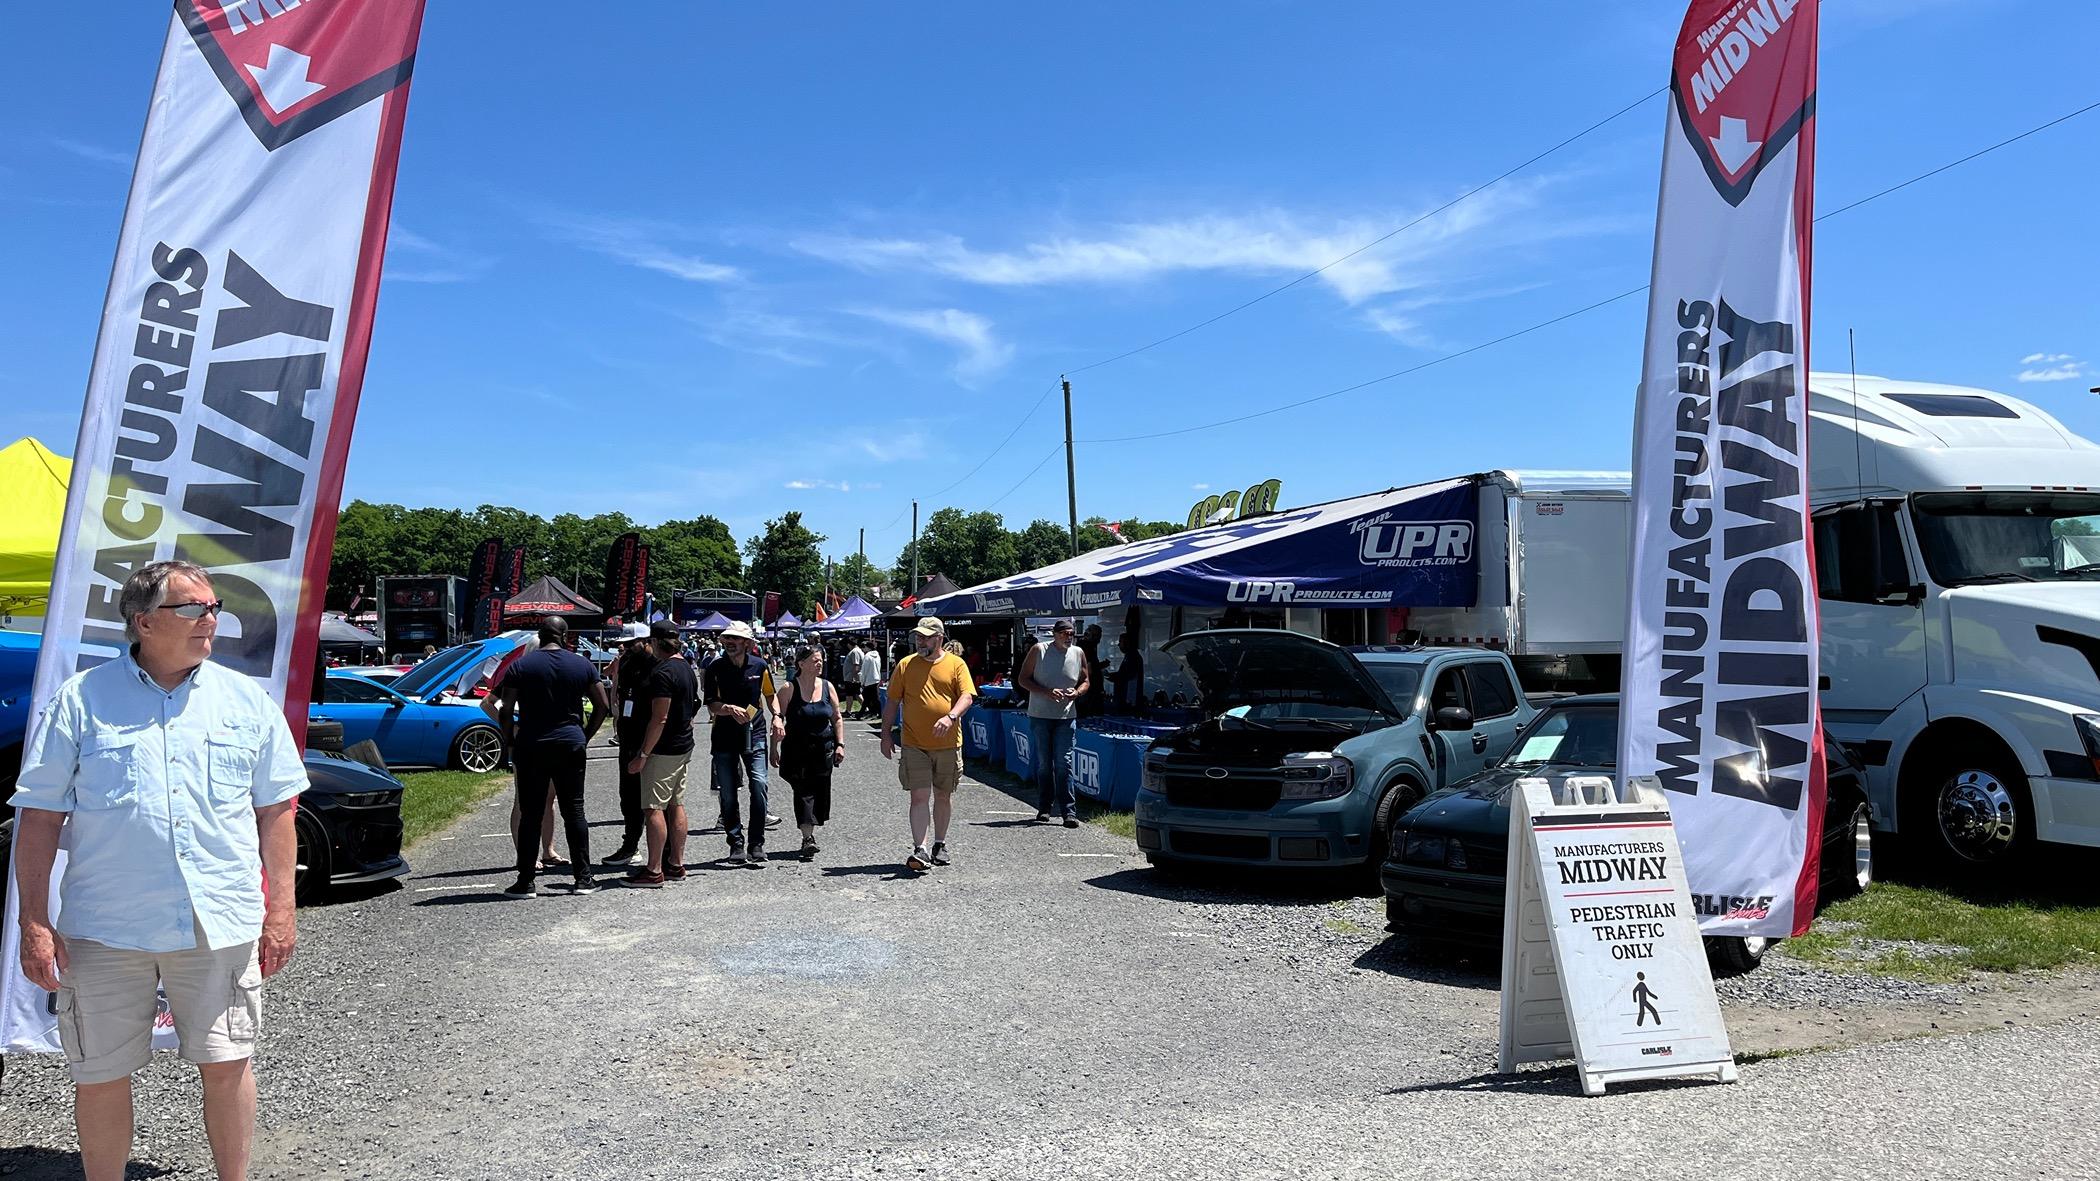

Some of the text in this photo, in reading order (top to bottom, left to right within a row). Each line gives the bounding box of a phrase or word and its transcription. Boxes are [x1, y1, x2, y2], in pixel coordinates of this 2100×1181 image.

[173, 249, 334, 678] DWAY
[1347, 511, 1393, 535] Team
[1363, 524, 1470, 559] UPR
[1656, 298, 1714, 796] MANUFACTURERS
[1712, 296, 1809, 811] MIDWAY
[1377, 557, 1457, 567] PRODUCTS.COM
[1062, 584, 1082, 610] UPR
[1226, 581, 1394, 602] UPR PRODUCTS.COM
[1072, 750, 1098, 788] UPR
[1554, 842, 1665, 857] MANUFACTURERS
[1557, 857, 1667, 884] MIDWAY
[1570, 903, 1676, 923] PEDESTRIAN
[1691, 894, 1776, 916] RLISLE
[1592, 923, 1665, 941] TRAFFIC
[1611, 942, 1653, 960] ONLY
